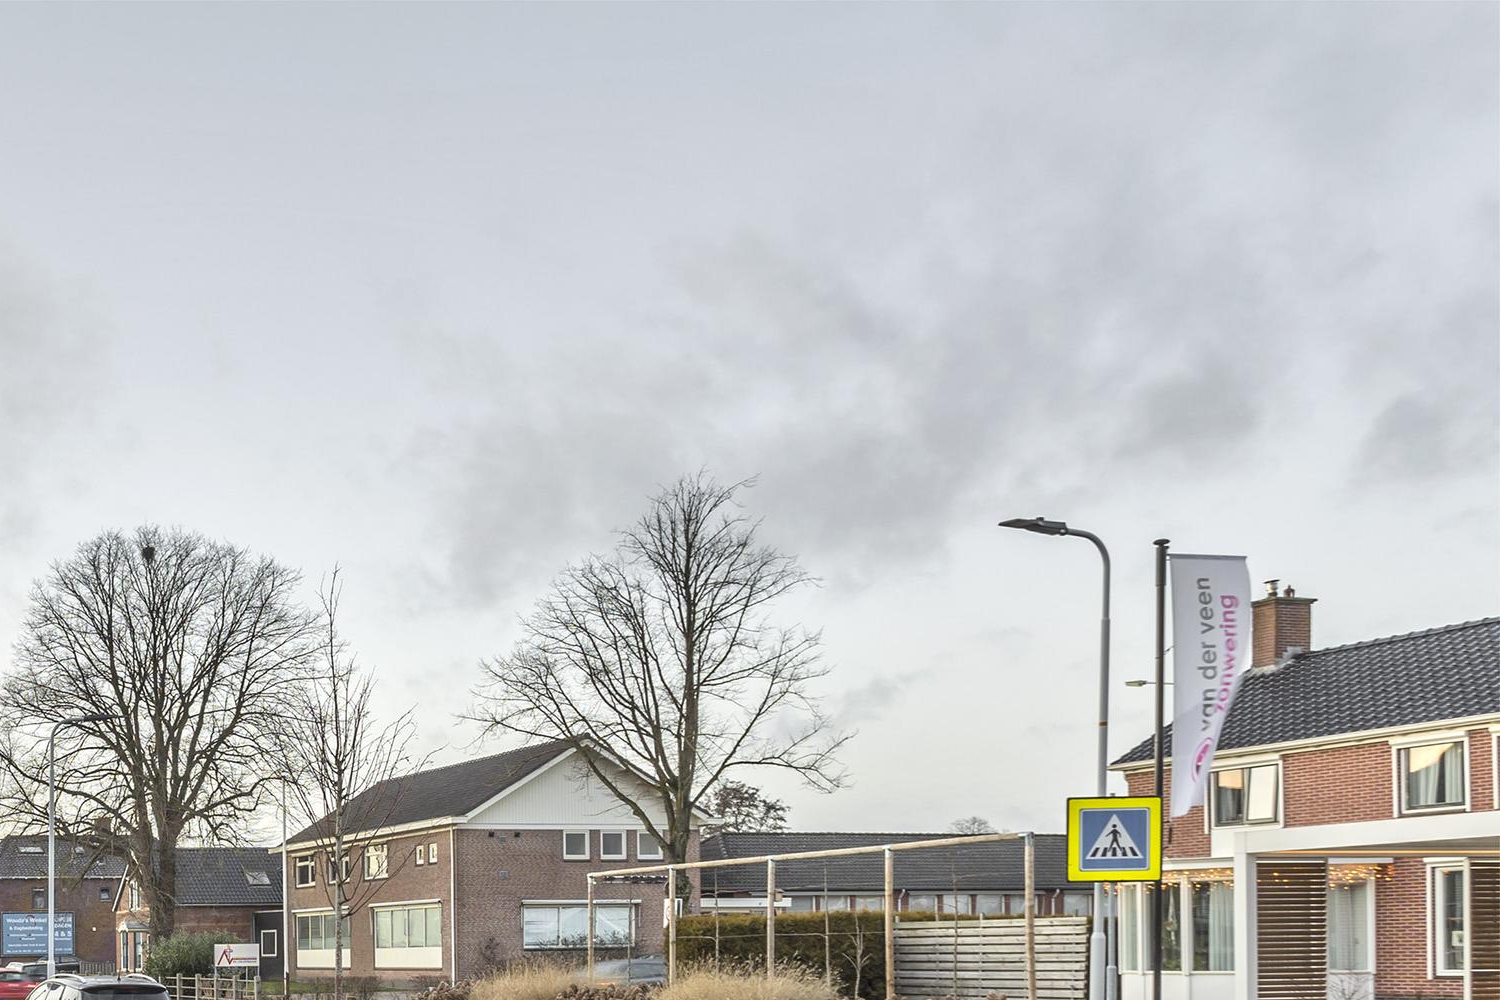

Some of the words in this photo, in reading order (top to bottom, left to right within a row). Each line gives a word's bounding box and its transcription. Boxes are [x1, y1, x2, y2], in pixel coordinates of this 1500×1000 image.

[1196, 577, 1215, 635] veen
[1197, 641, 1217, 680] der
[1214, 594, 1240, 713] zonwering
[1201, 688, 1217, 732] van
